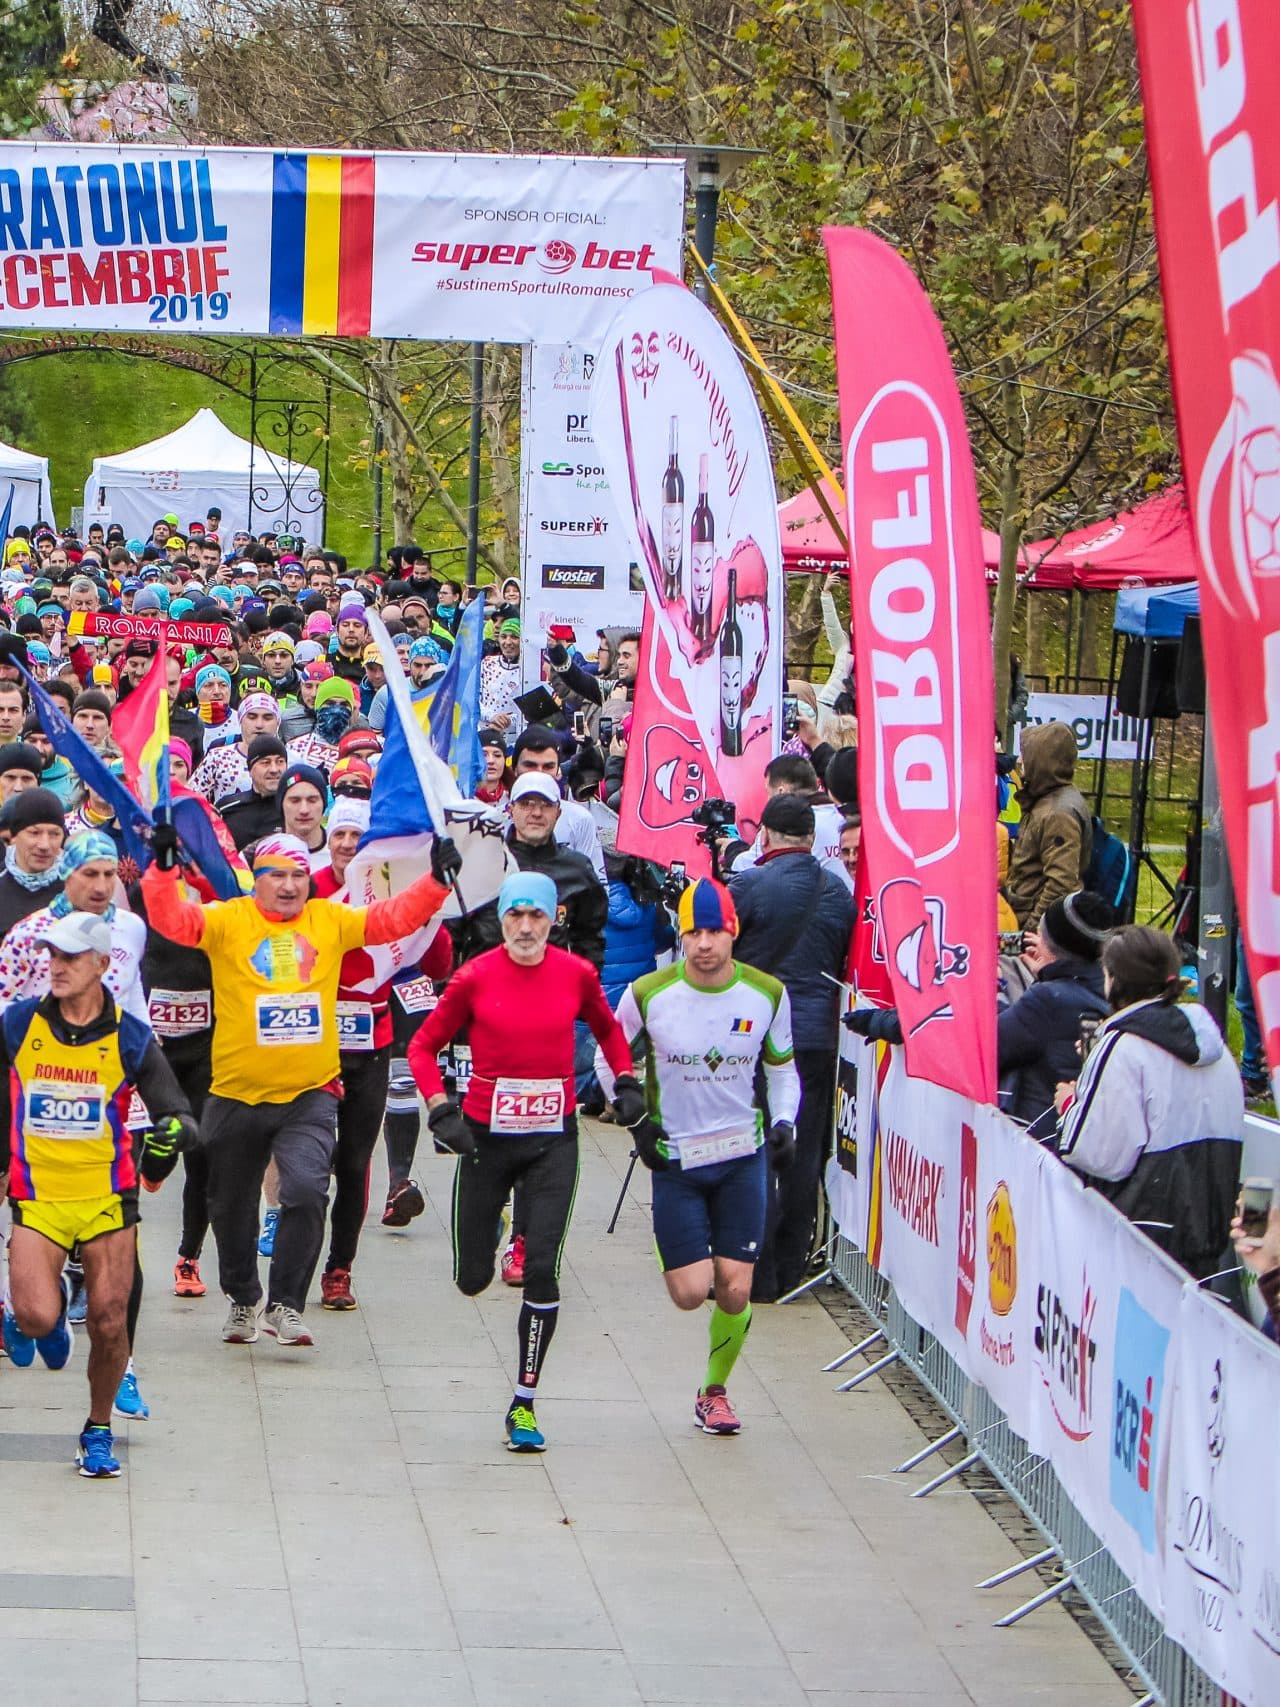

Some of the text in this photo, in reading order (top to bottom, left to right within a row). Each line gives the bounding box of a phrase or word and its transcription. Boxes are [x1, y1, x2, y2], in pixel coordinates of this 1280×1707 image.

[464, 209, 606, 225] SPONSOR OFICIAL:
[412, 242, 656, 271] super bet
[148, 294, 229, 323] 2019
[540, 516, 609, 535] SUPERFIT
[554, 616, 585, 624] kinetic
[95, 616, 233, 647] ROMANIA
[401, 982, 433, 1000] 233
[151, 1004, 205, 1021] 2132
[269, 1008, 311, 1028] 245
[34, 1063, 98, 1084] ROMANIA
[40, 1099, 90, 1120] 300
[498, 1096, 559, 1115] 2145
